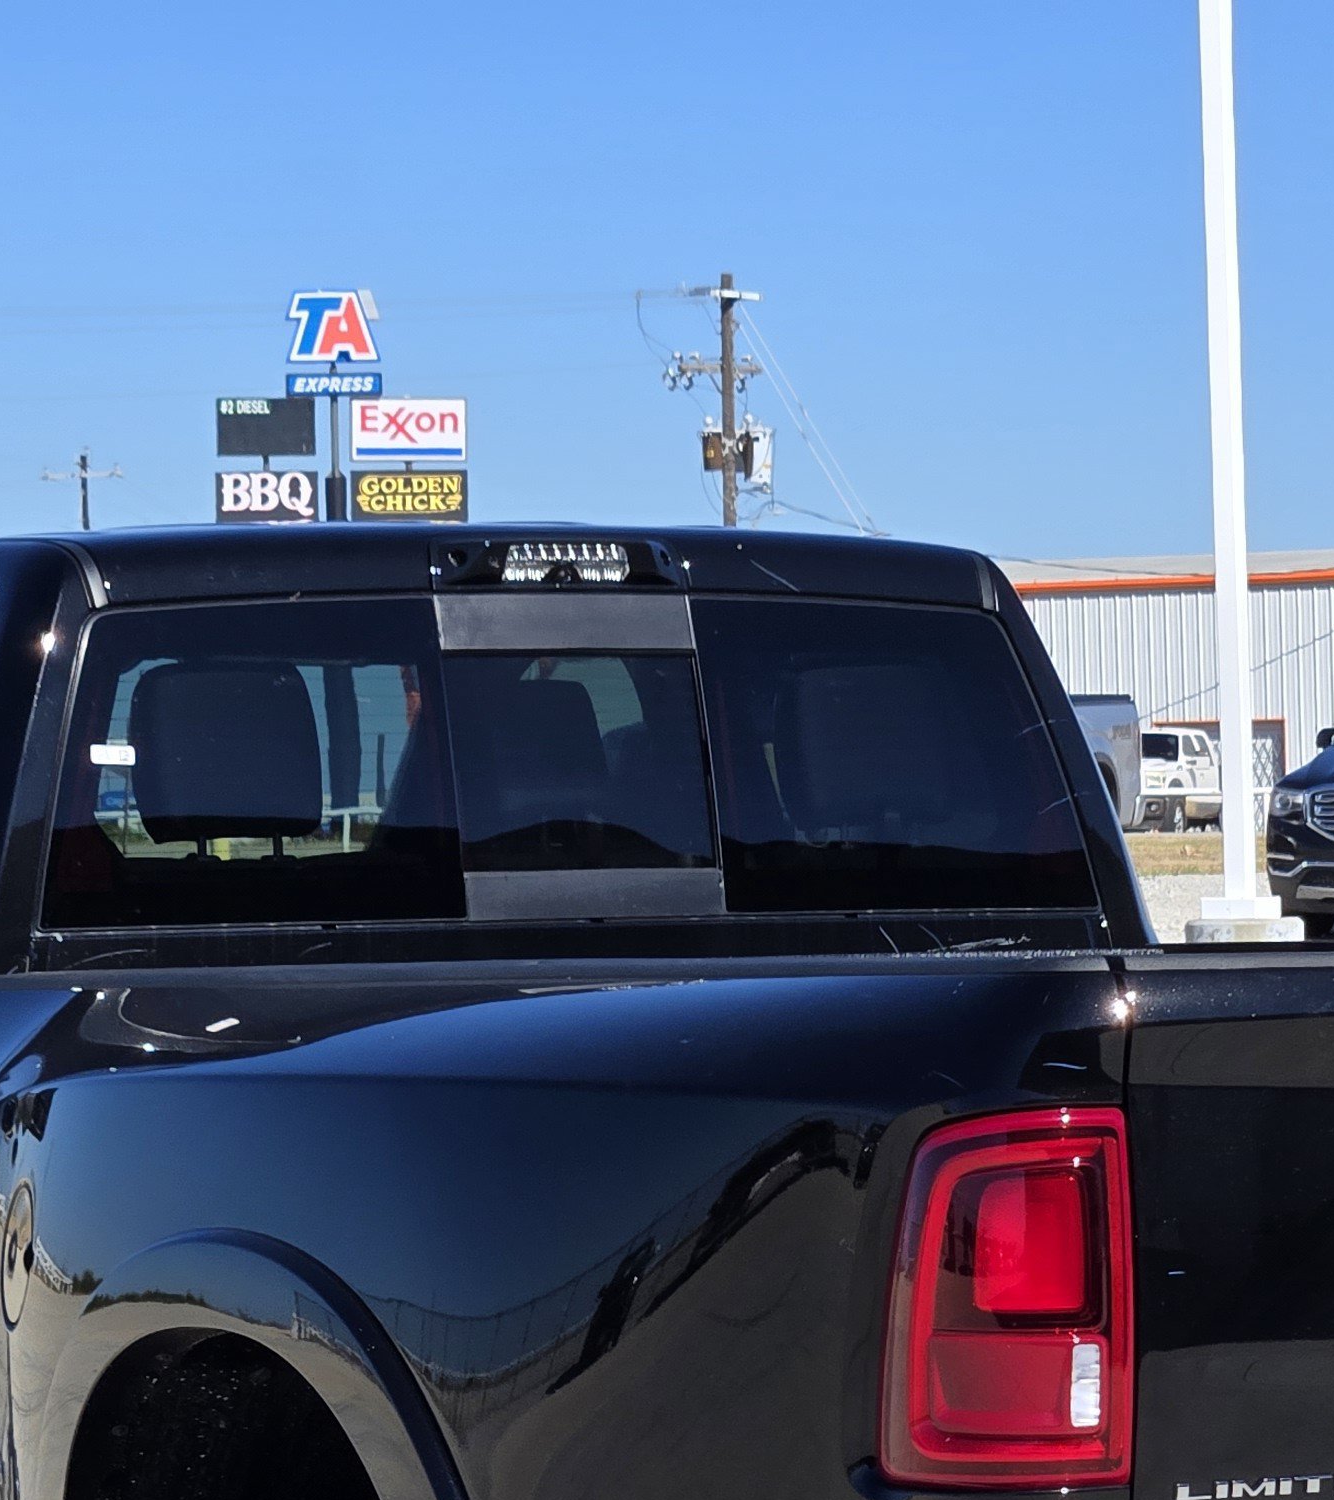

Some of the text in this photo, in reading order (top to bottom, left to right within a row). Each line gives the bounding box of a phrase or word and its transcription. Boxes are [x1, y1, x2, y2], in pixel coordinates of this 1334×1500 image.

[291, 292, 377, 360] TA
[293, 375, 373, 393] EXPRESS
[236, 399, 270, 414] DIESEL
[360, 405, 459, 443] Exxon
[221, 472, 314, 516] BBQ
[361, 476, 460, 494] GOLDEN
[367, 493, 446, 512] CHICK
